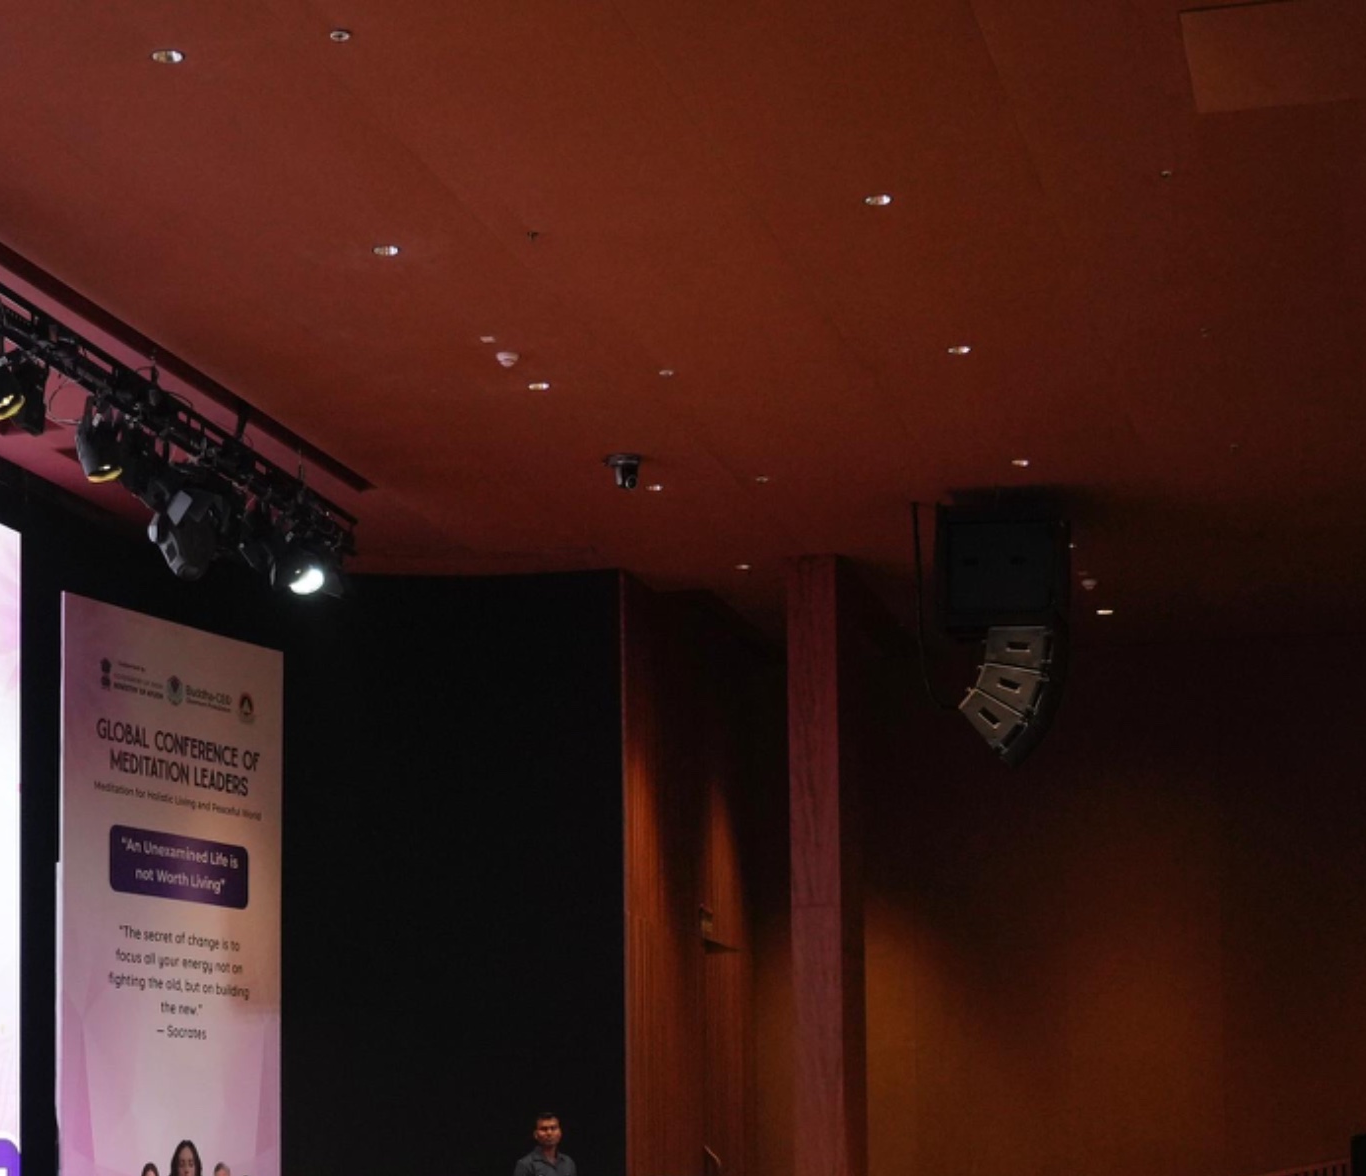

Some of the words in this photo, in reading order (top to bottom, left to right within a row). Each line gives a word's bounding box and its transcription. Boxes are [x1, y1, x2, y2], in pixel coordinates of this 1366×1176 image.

[96, 718, 149, 749] GLOBAL
[155, 731, 238, 768] CONFERENCE
[242, 750, 260, 771] OF
[110, 748, 190, 785] MEDITATION
[194, 766, 248, 796] LEADERS
[94, 781, 134, 797] Meditation
[136, 788, 146, 799] for
[143, 841, 207, 864] Unexamined
[210, 852, 228, 867] Life
[230, 855, 238, 869] is
[135, 868, 154, 881] not
[156, 870, 189, 886] Worth
[143, 930, 172, 944] secret
[175, 932, 186, 944] of
[188, 933, 219, 952] change
[222, 938, 229, 949] is
[231, 940, 240, 952] to
[115, 948, 142, 963] focus
[143, 952, 156, 965] all
[157, 956, 179, 970] your
[182, 958, 213, 973] energy
[215, 960, 230, 972] not
[232, 963, 242, 973] on
[108, 971, 146, 991] fighting
[148, 974, 163, 989] the
[185, 979, 200, 992] but
[202, 982, 214, 993] on
[216, 983, 250, 1000] building
[161, 1001, 176, 1014] the
[167, 1024, 207, 1040] Socrates
